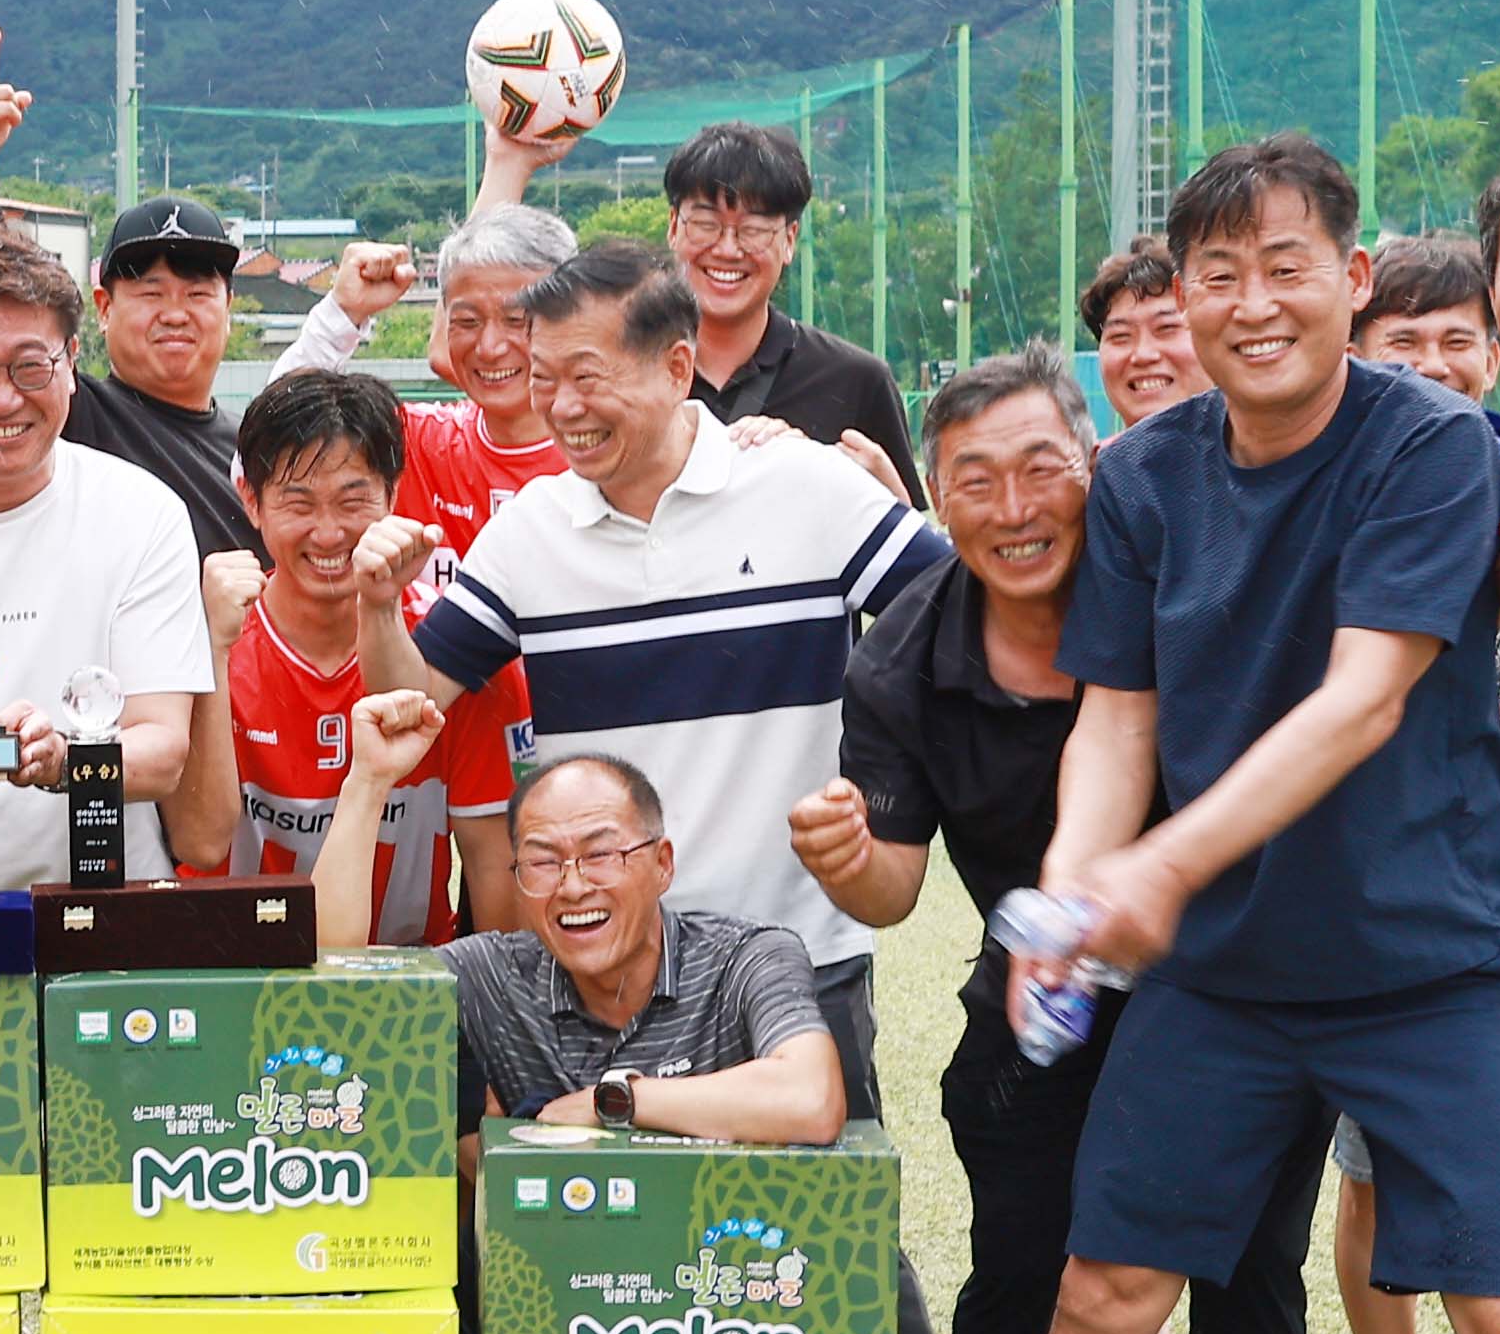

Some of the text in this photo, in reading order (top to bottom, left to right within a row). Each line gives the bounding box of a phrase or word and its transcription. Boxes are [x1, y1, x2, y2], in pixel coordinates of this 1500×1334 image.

[316, 713, 347, 770] 9
[132, 1105, 214, 1121] 싱그러운 자연의
[136, 1140, 365, 1213] Melon
[569, 1273, 651, 1289] 싱그러운 자연의
